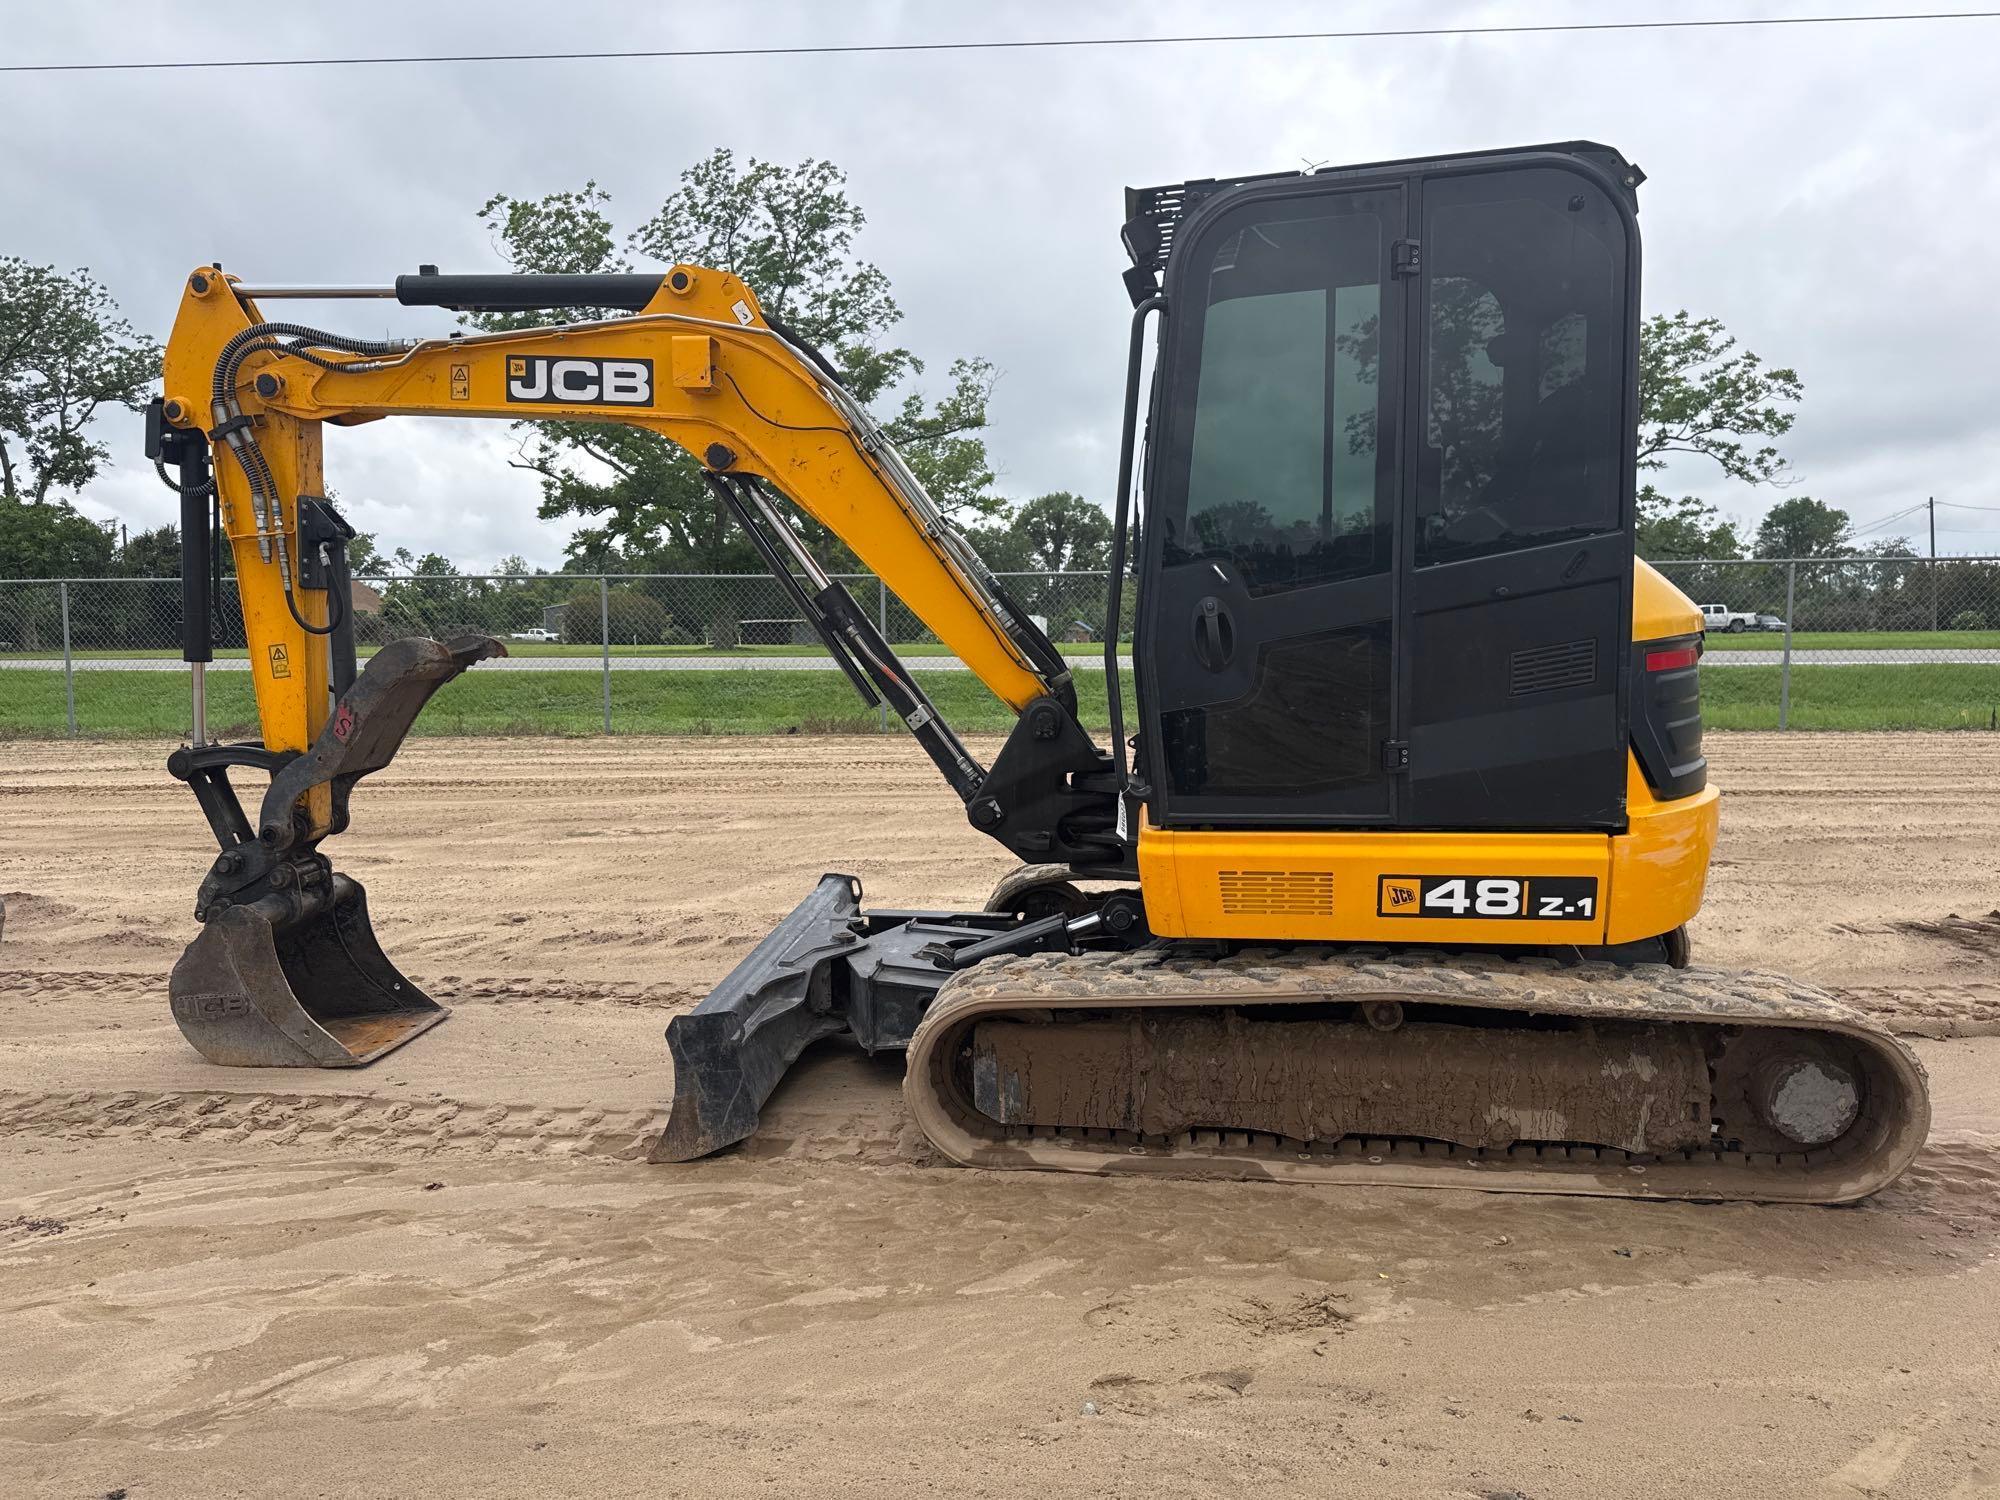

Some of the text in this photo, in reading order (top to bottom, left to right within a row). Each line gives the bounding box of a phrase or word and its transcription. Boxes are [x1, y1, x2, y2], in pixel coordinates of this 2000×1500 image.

[510, 359, 650, 402] JCB
[1391, 885, 1415, 904] JCB
[1425, 879, 1593, 916] 48 Z-1
